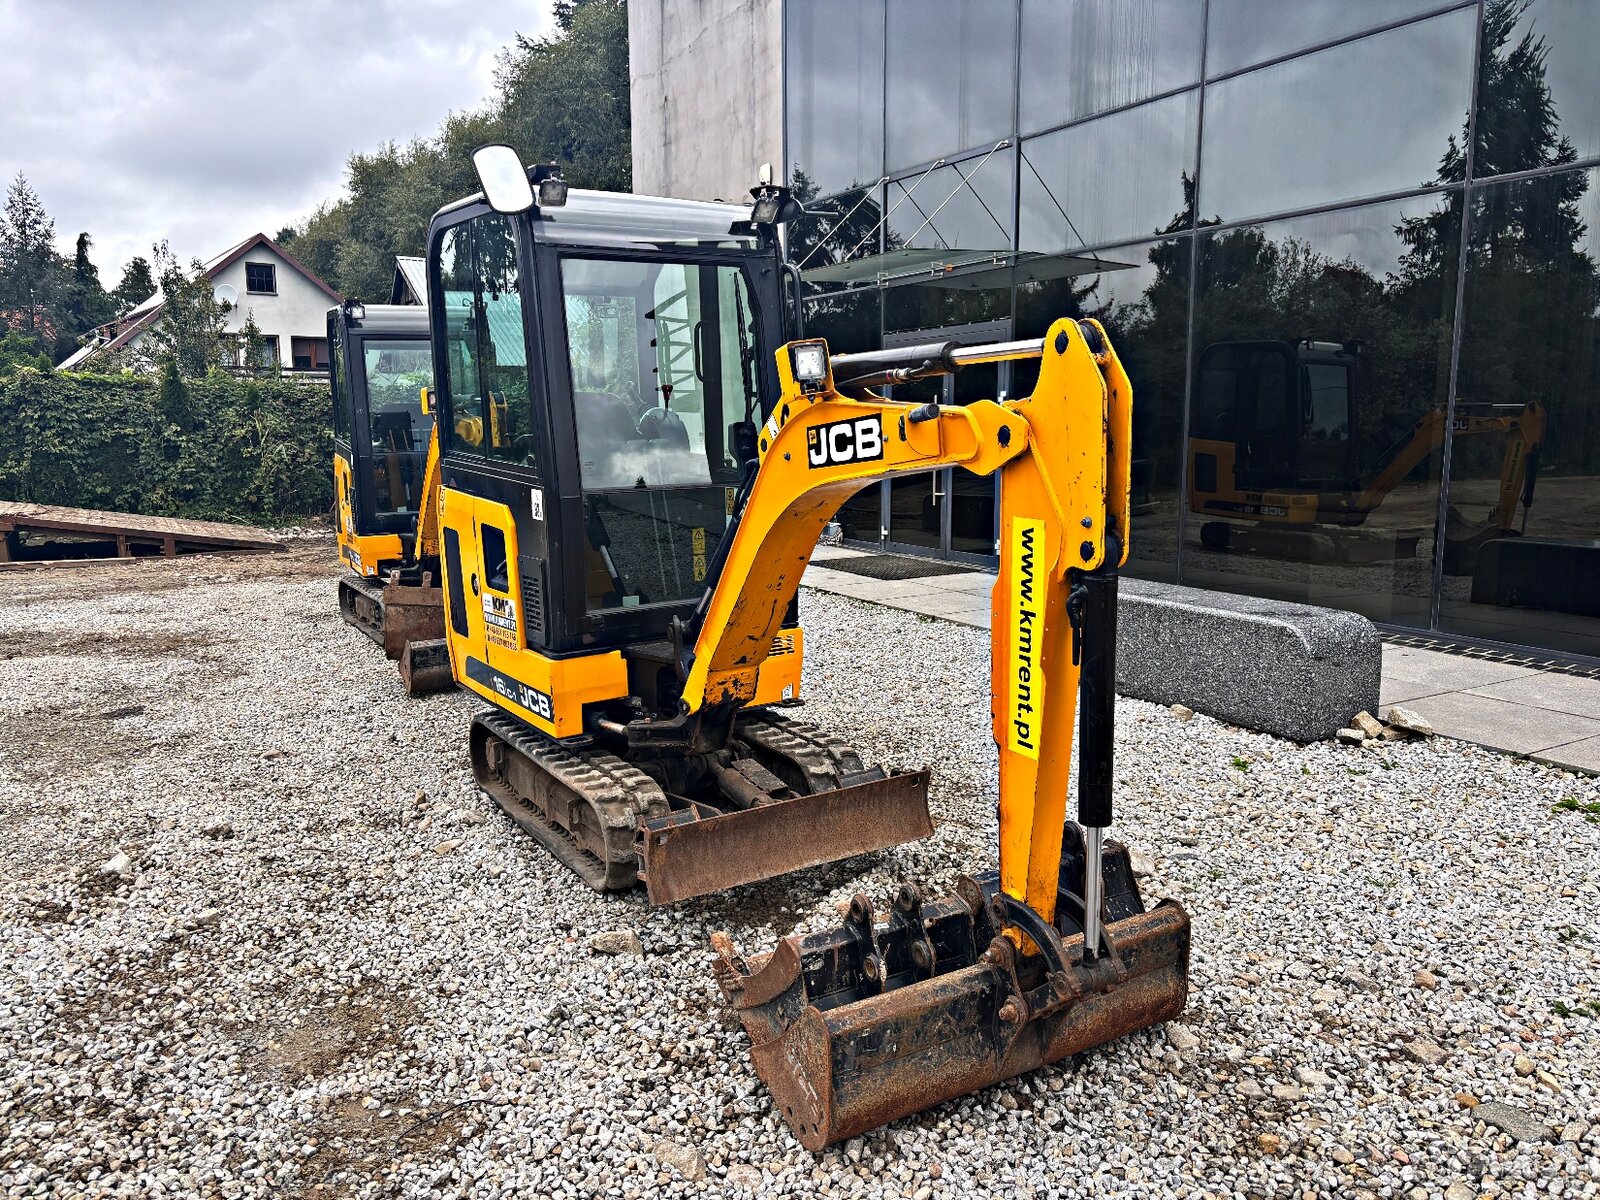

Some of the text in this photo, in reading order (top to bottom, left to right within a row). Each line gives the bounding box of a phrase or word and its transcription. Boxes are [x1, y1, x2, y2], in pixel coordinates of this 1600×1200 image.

[809, 418, 881, 465] JCB
[1013, 527, 1037, 750] www.kmrent.pl
[520, 685, 551, 719] JCB
